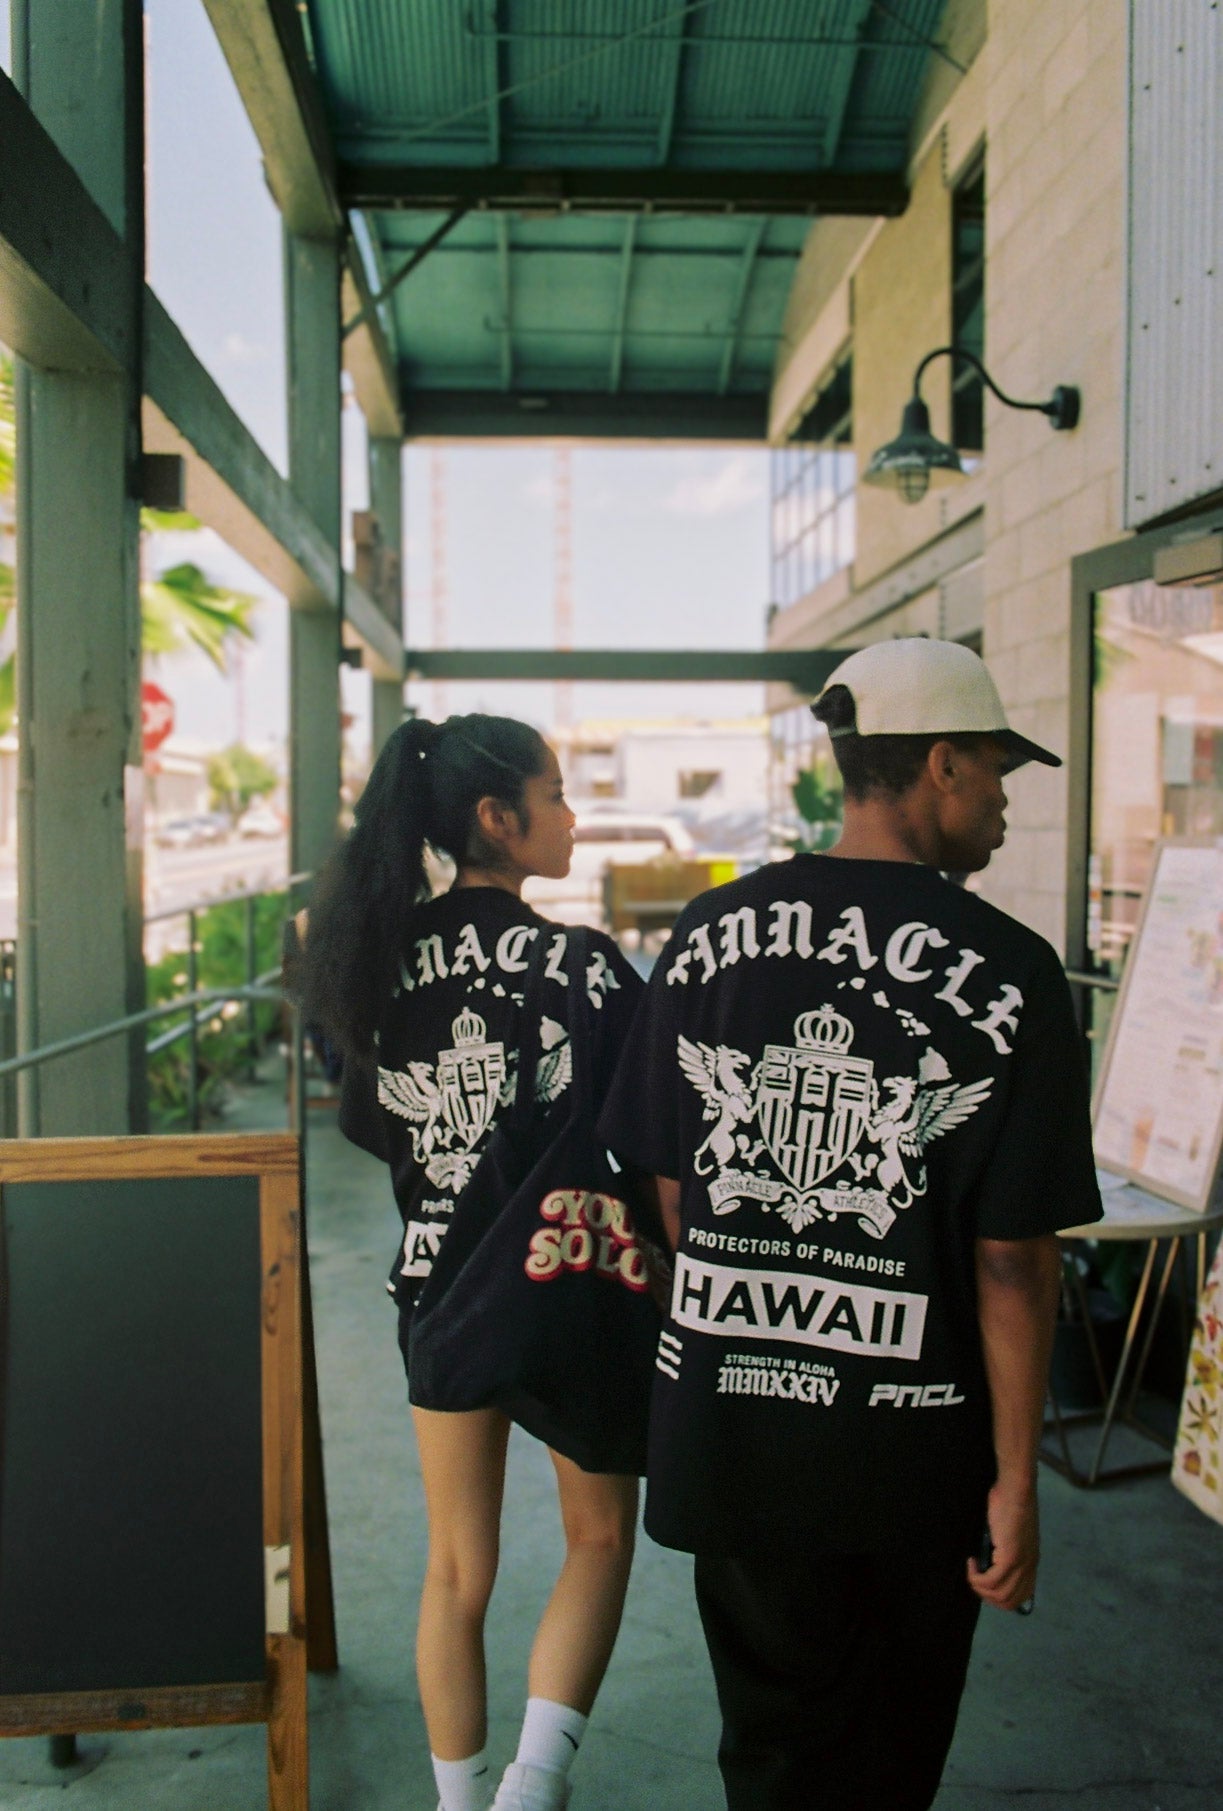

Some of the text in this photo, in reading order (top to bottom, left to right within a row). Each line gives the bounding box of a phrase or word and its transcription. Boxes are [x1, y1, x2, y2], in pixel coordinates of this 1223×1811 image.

[688, 1227, 906, 1277] PROTECTORS OF PARADISE
[680, 1268, 907, 1346] HAWAII
[724, 1353, 836, 1379] STRENGTH IN ALOHA
